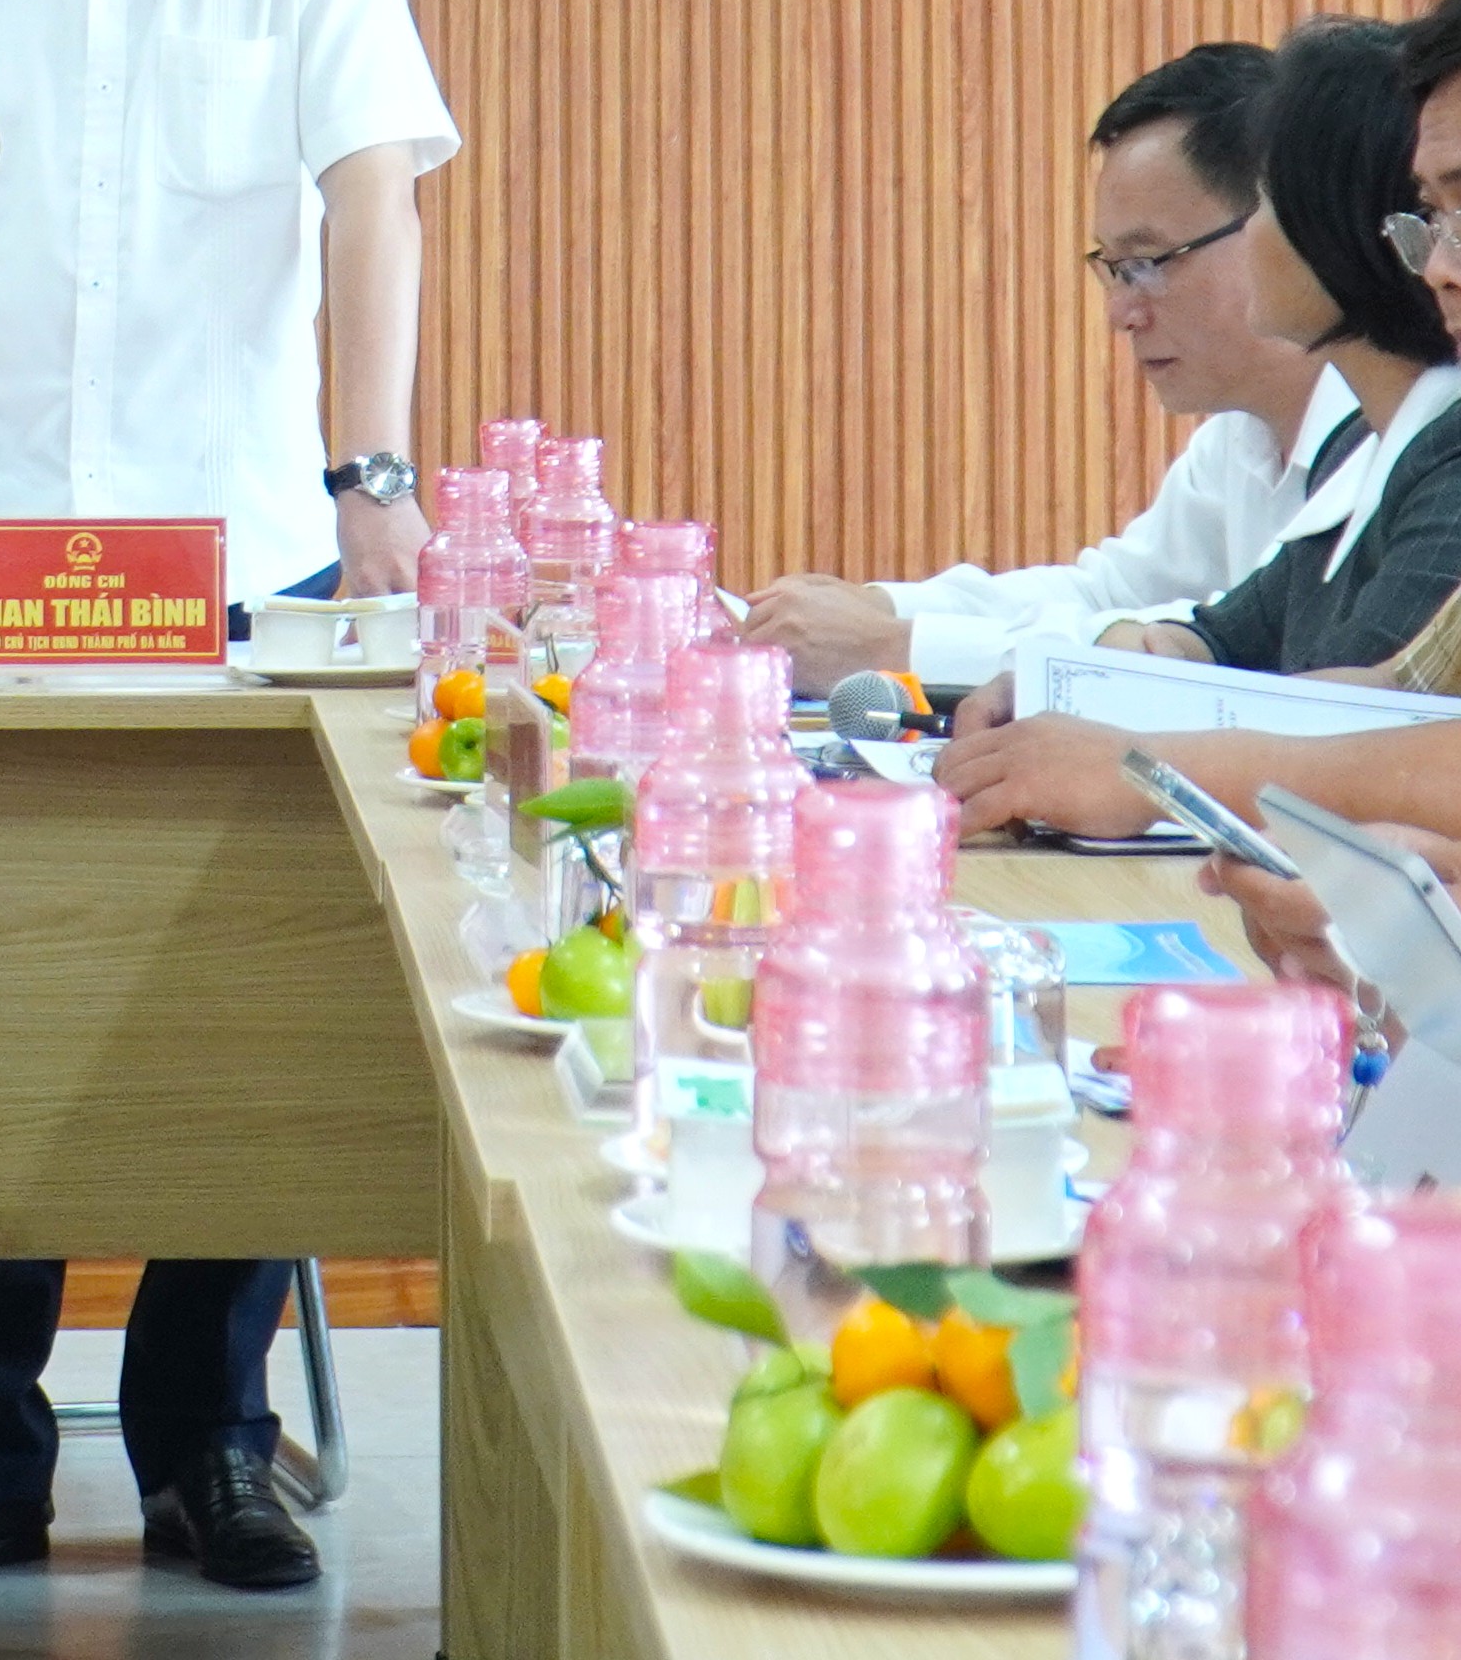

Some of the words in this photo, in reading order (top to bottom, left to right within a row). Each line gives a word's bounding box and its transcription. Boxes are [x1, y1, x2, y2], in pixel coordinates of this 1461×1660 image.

[98, 573, 125, 589] CHÍ
[50, 592, 123, 627] THÁI
[130, 593, 206, 627] BÌNH
